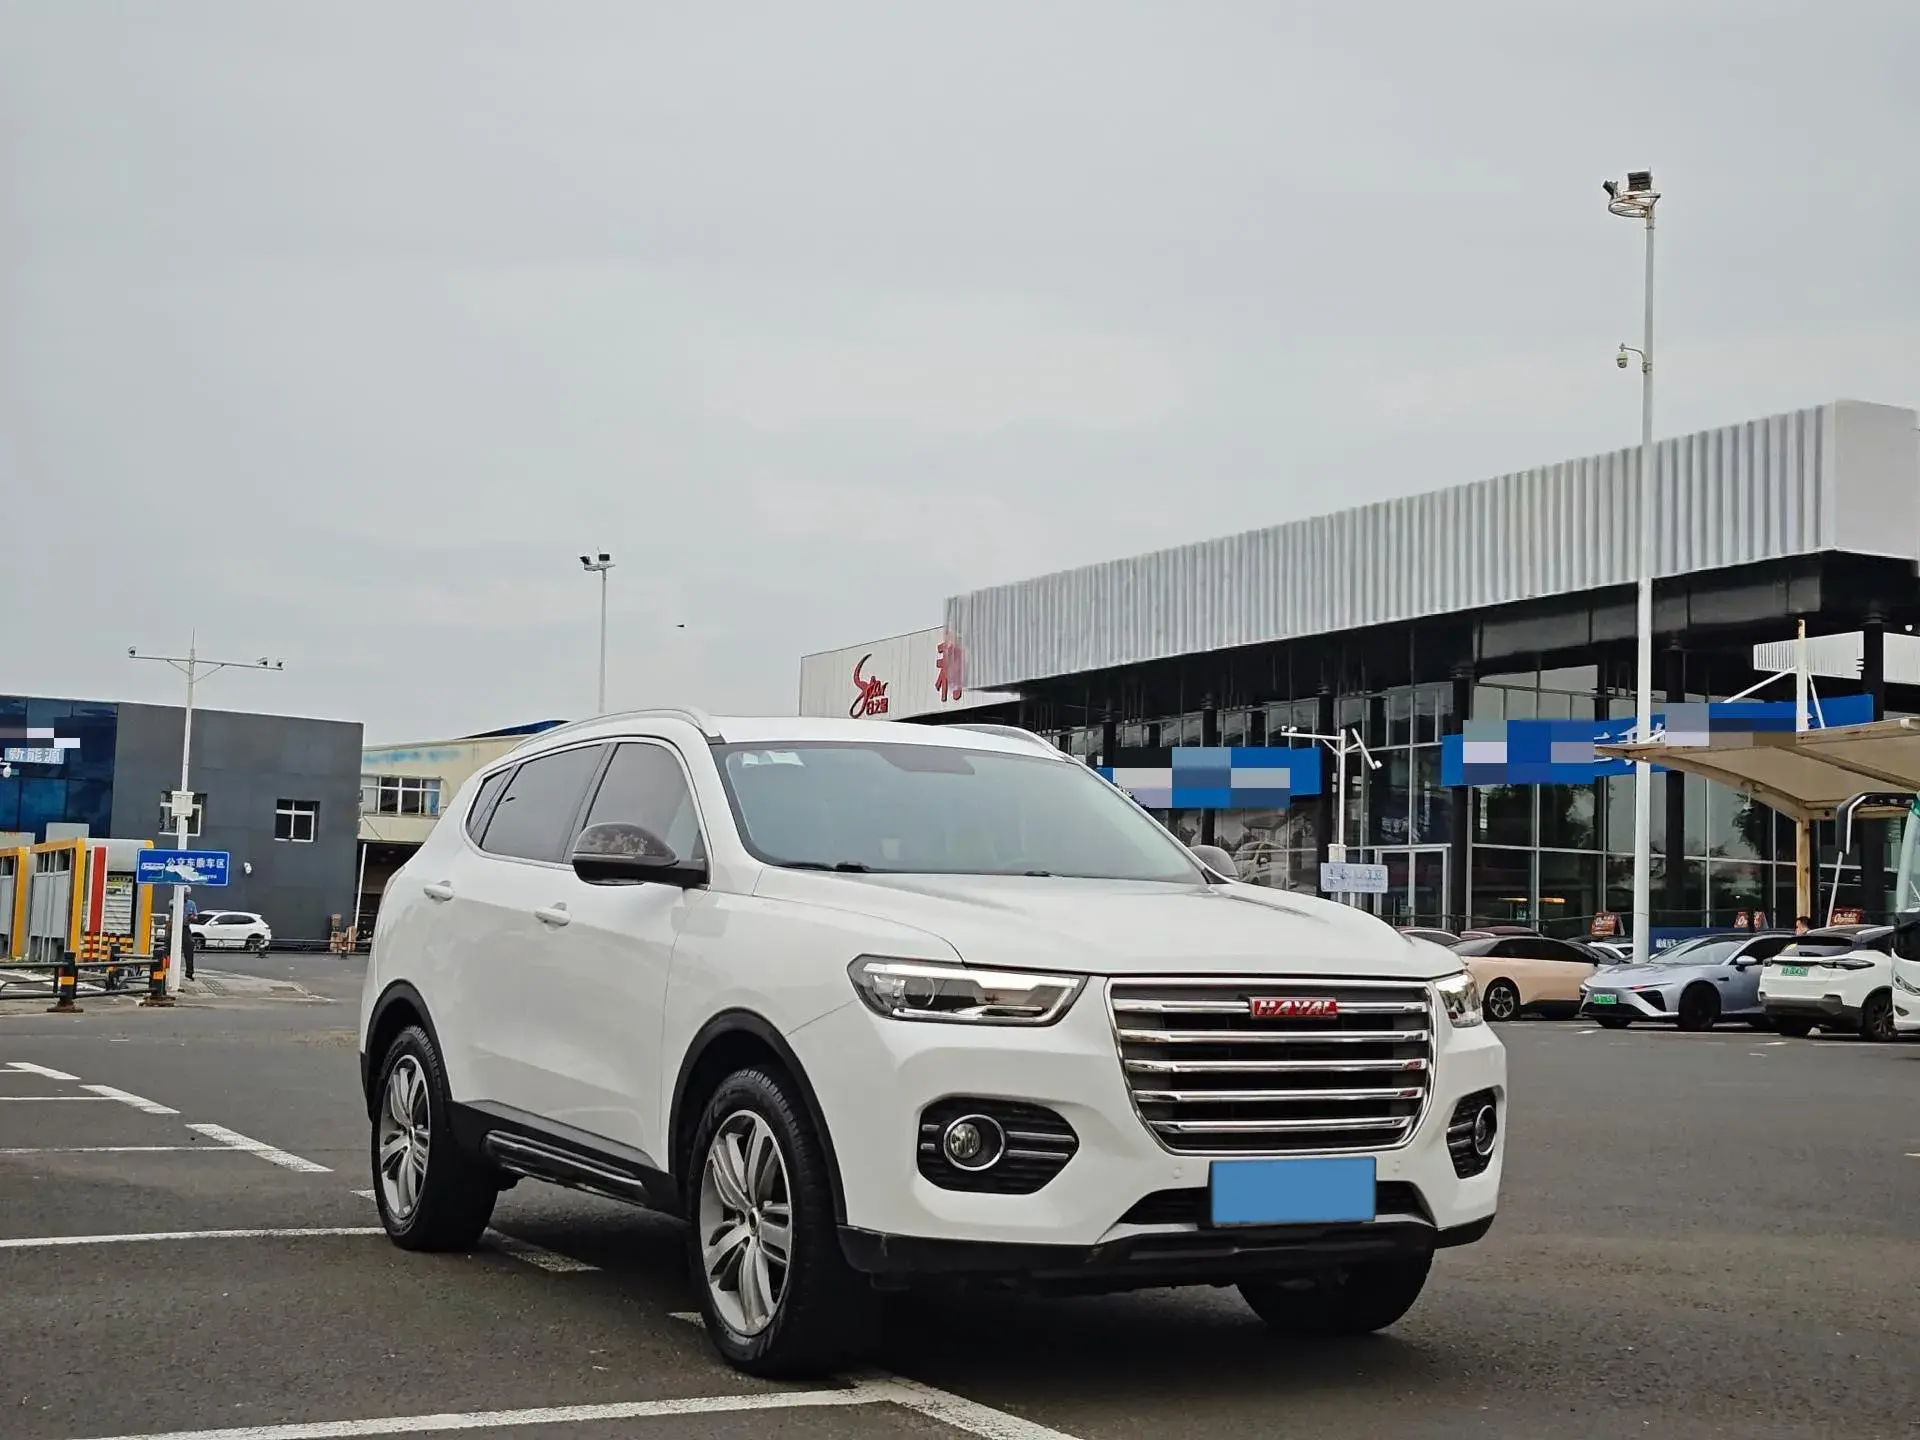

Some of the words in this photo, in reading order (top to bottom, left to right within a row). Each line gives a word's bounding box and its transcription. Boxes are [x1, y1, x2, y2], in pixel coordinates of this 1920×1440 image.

[8, 748, 61, 764] 新能源
[1256, 1000, 1336, 1016] HAVAL
